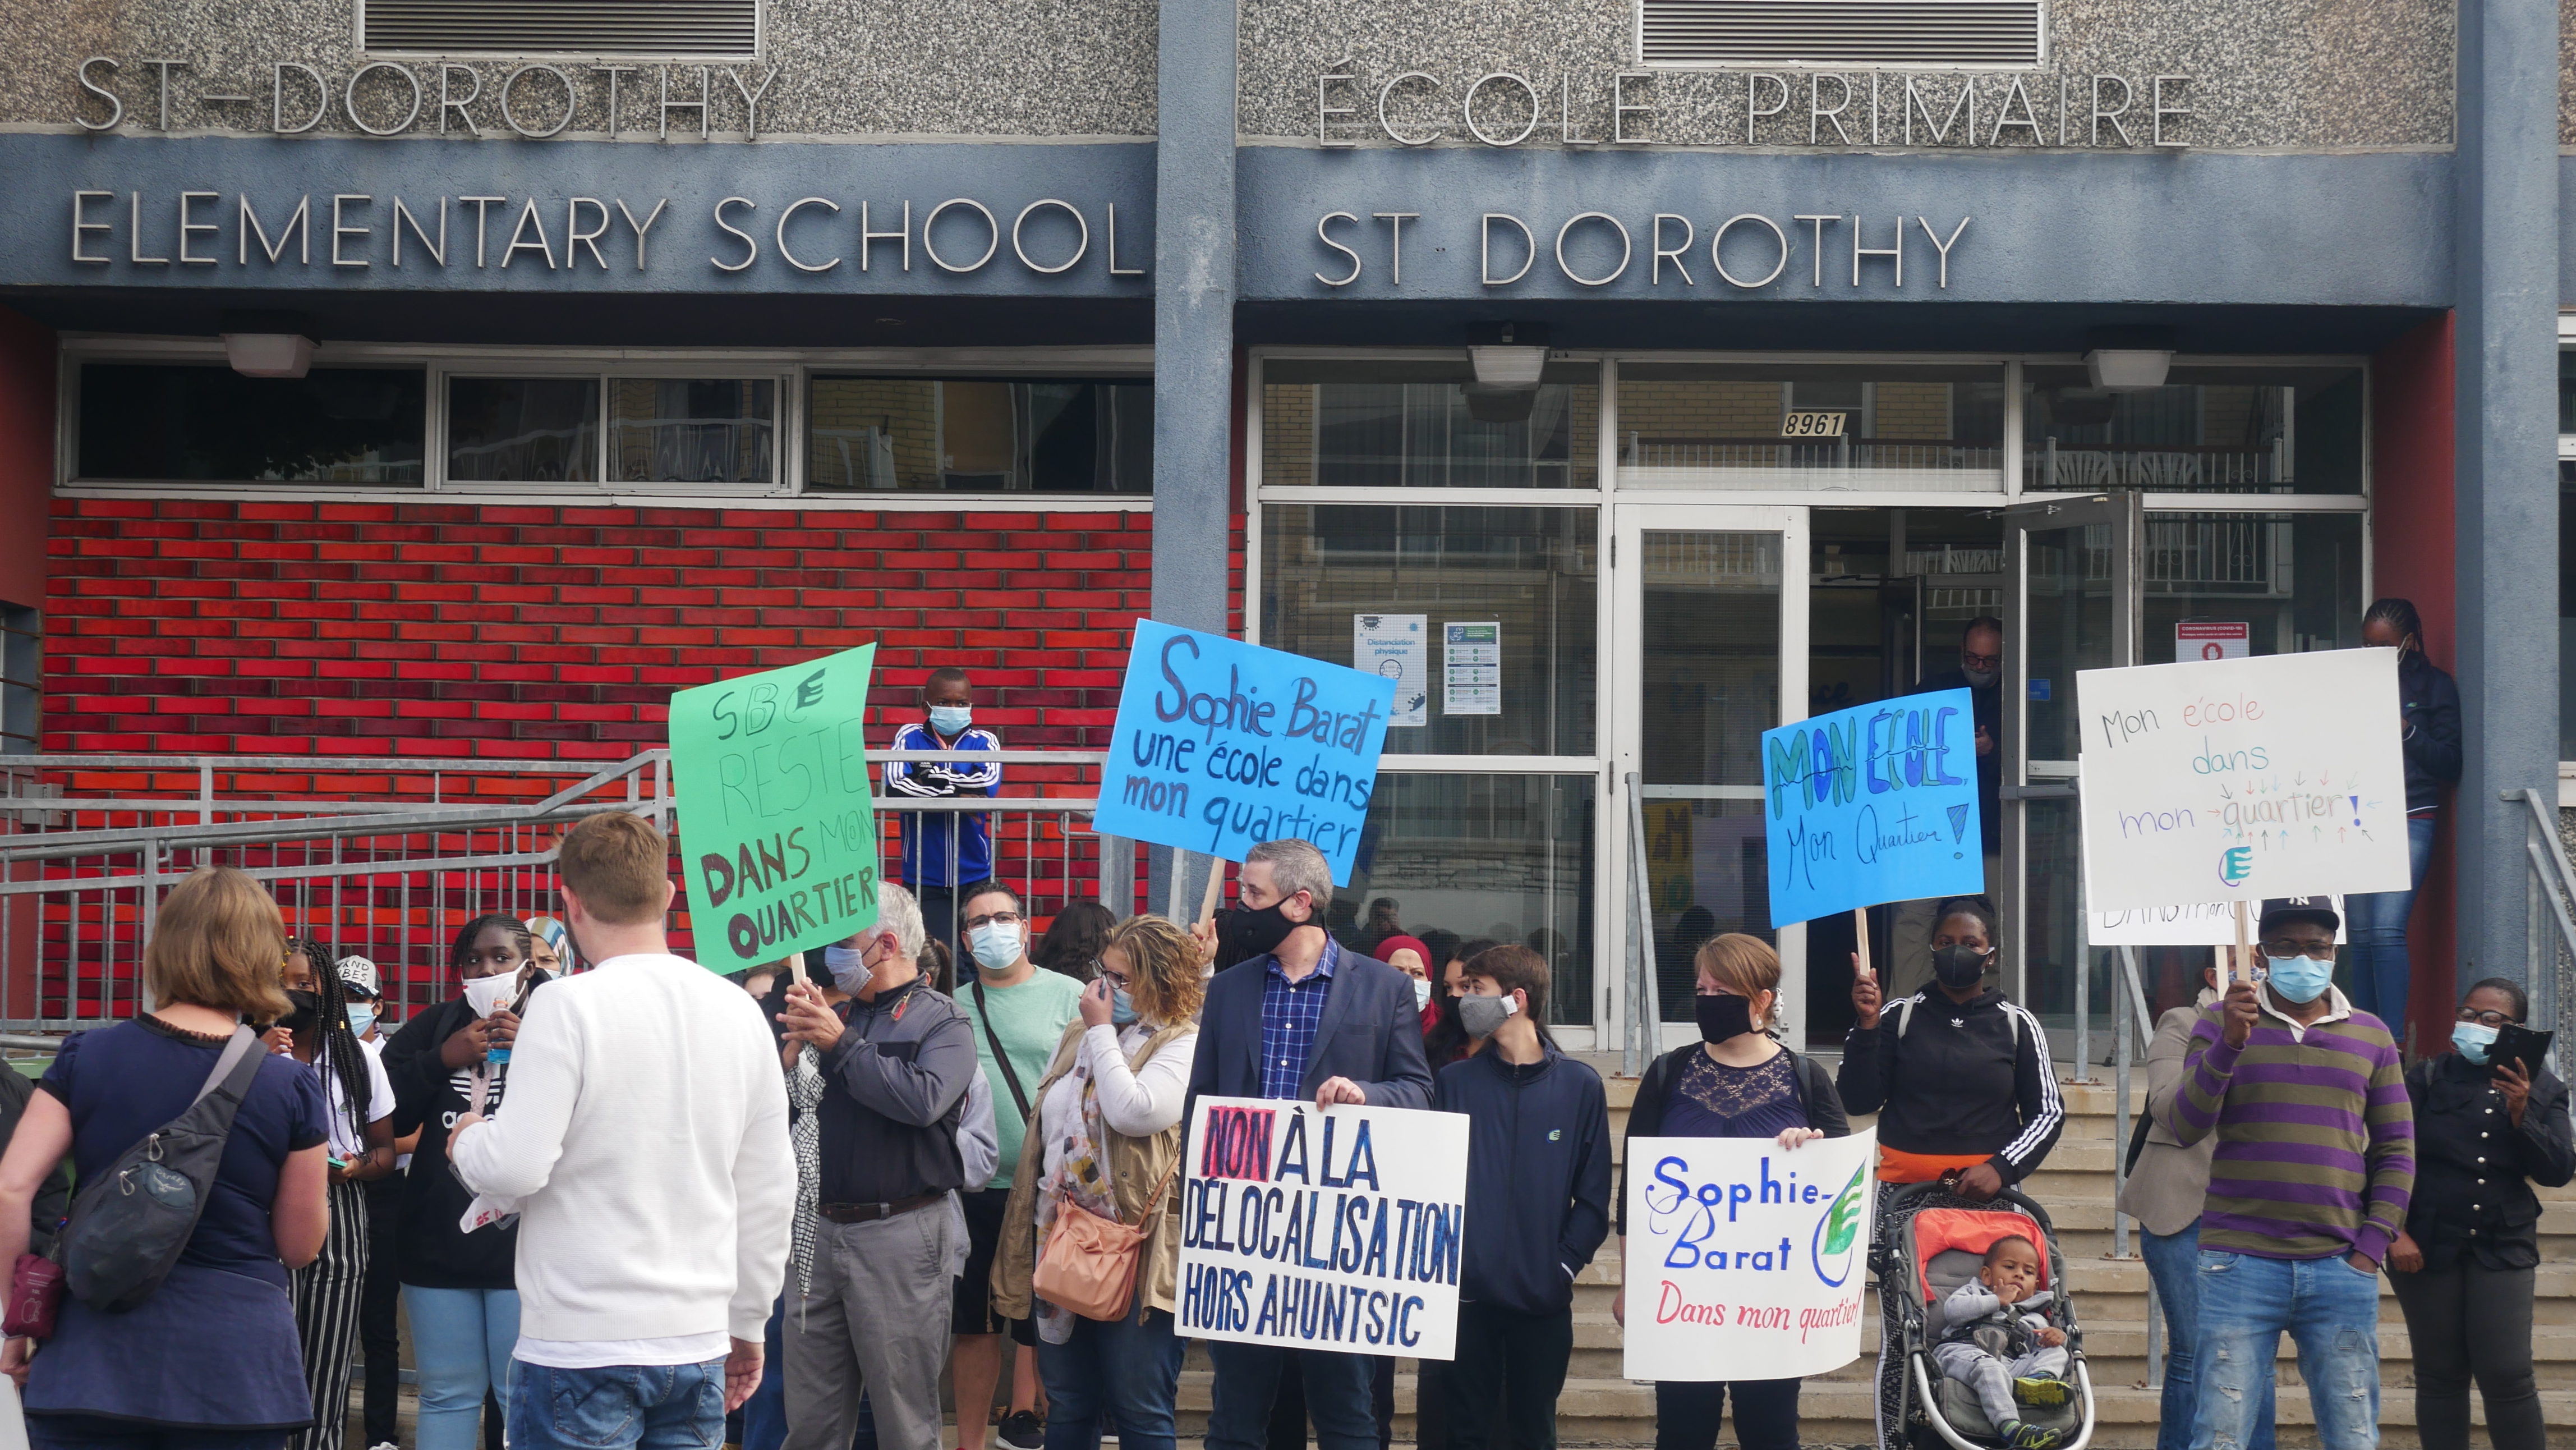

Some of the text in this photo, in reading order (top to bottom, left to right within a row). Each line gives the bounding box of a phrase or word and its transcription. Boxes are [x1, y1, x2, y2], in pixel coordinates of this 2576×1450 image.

[1319, 56, 2191, 147] ÉCOLE PRIMAIRE
[72, 190, 1147, 275] ELEMENTARY SCHOOL
[1314, 211, 1971, 288] ST DOROTHY
[1785, 414, 1841, 435] 8961
[1155, 634, 1381, 756] Sophie Barat
[2101, 692, 2264, 748] Mon école
[719, 718, 866, 825] RESTE
[1133, 729, 1371, 811] une école dans
[1770, 716, 1856, 820] MON
[2193, 736, 2269, 774] dans
[1123, 773, 1357, 852] mon quartier
[1786, 815, 1837, 891] Mon
[2119, 808, 2195, 838] mon
[700, 805, 876, 908] DANS MON
[728, 865, 876, 960] QUARTIER
[1202, 1105, 1381, 1191] NON À LA
[1645, 1155, 1834, 1222] Sophie-
[1184, 1176, 1462, 1286] DÉLOCALISATION
[1649, 1194, 1792, 1272] Barat
[1183, 1262, 1425, 1348] HORS AHUNTSIC
[1656, 1280, 1727, 1326] Dans
[1737, 1305, 1791, 1330] mon
